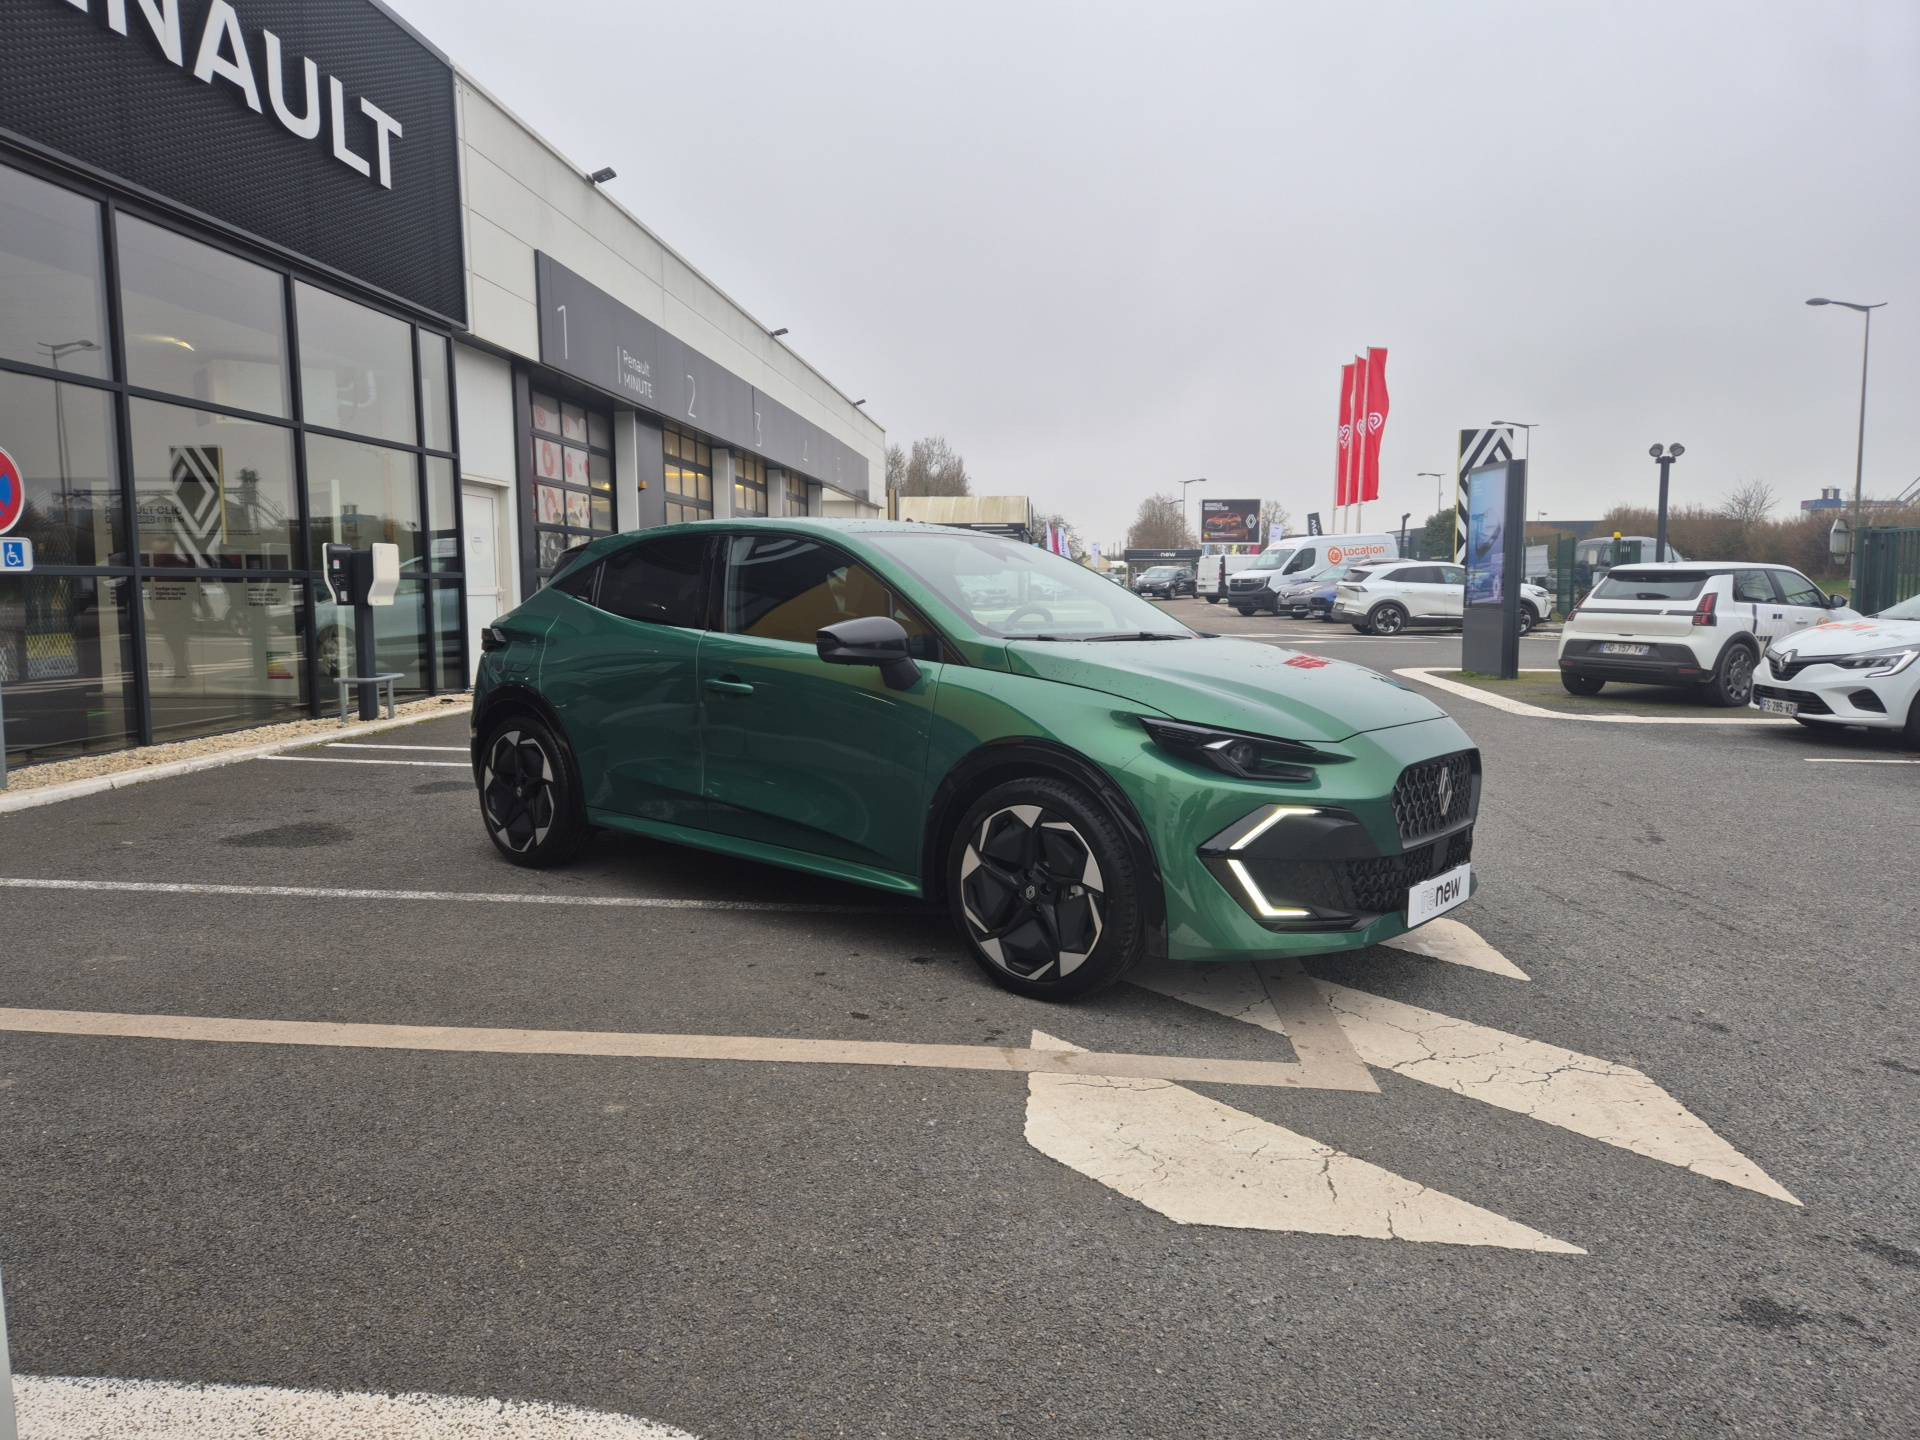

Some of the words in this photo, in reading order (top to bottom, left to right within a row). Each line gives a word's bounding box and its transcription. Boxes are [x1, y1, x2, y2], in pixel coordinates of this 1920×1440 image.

[64, 0, 403, 190] NAULT
[557, 305, 568, 360] 1
[623, 350, 651, 377] Renault
[624, 372, 653, 399] MINUTE
[686, 374, 697, 419] 2
[754, 411, 762, 447] 3
[1343, 545, 1385, 556] Location
